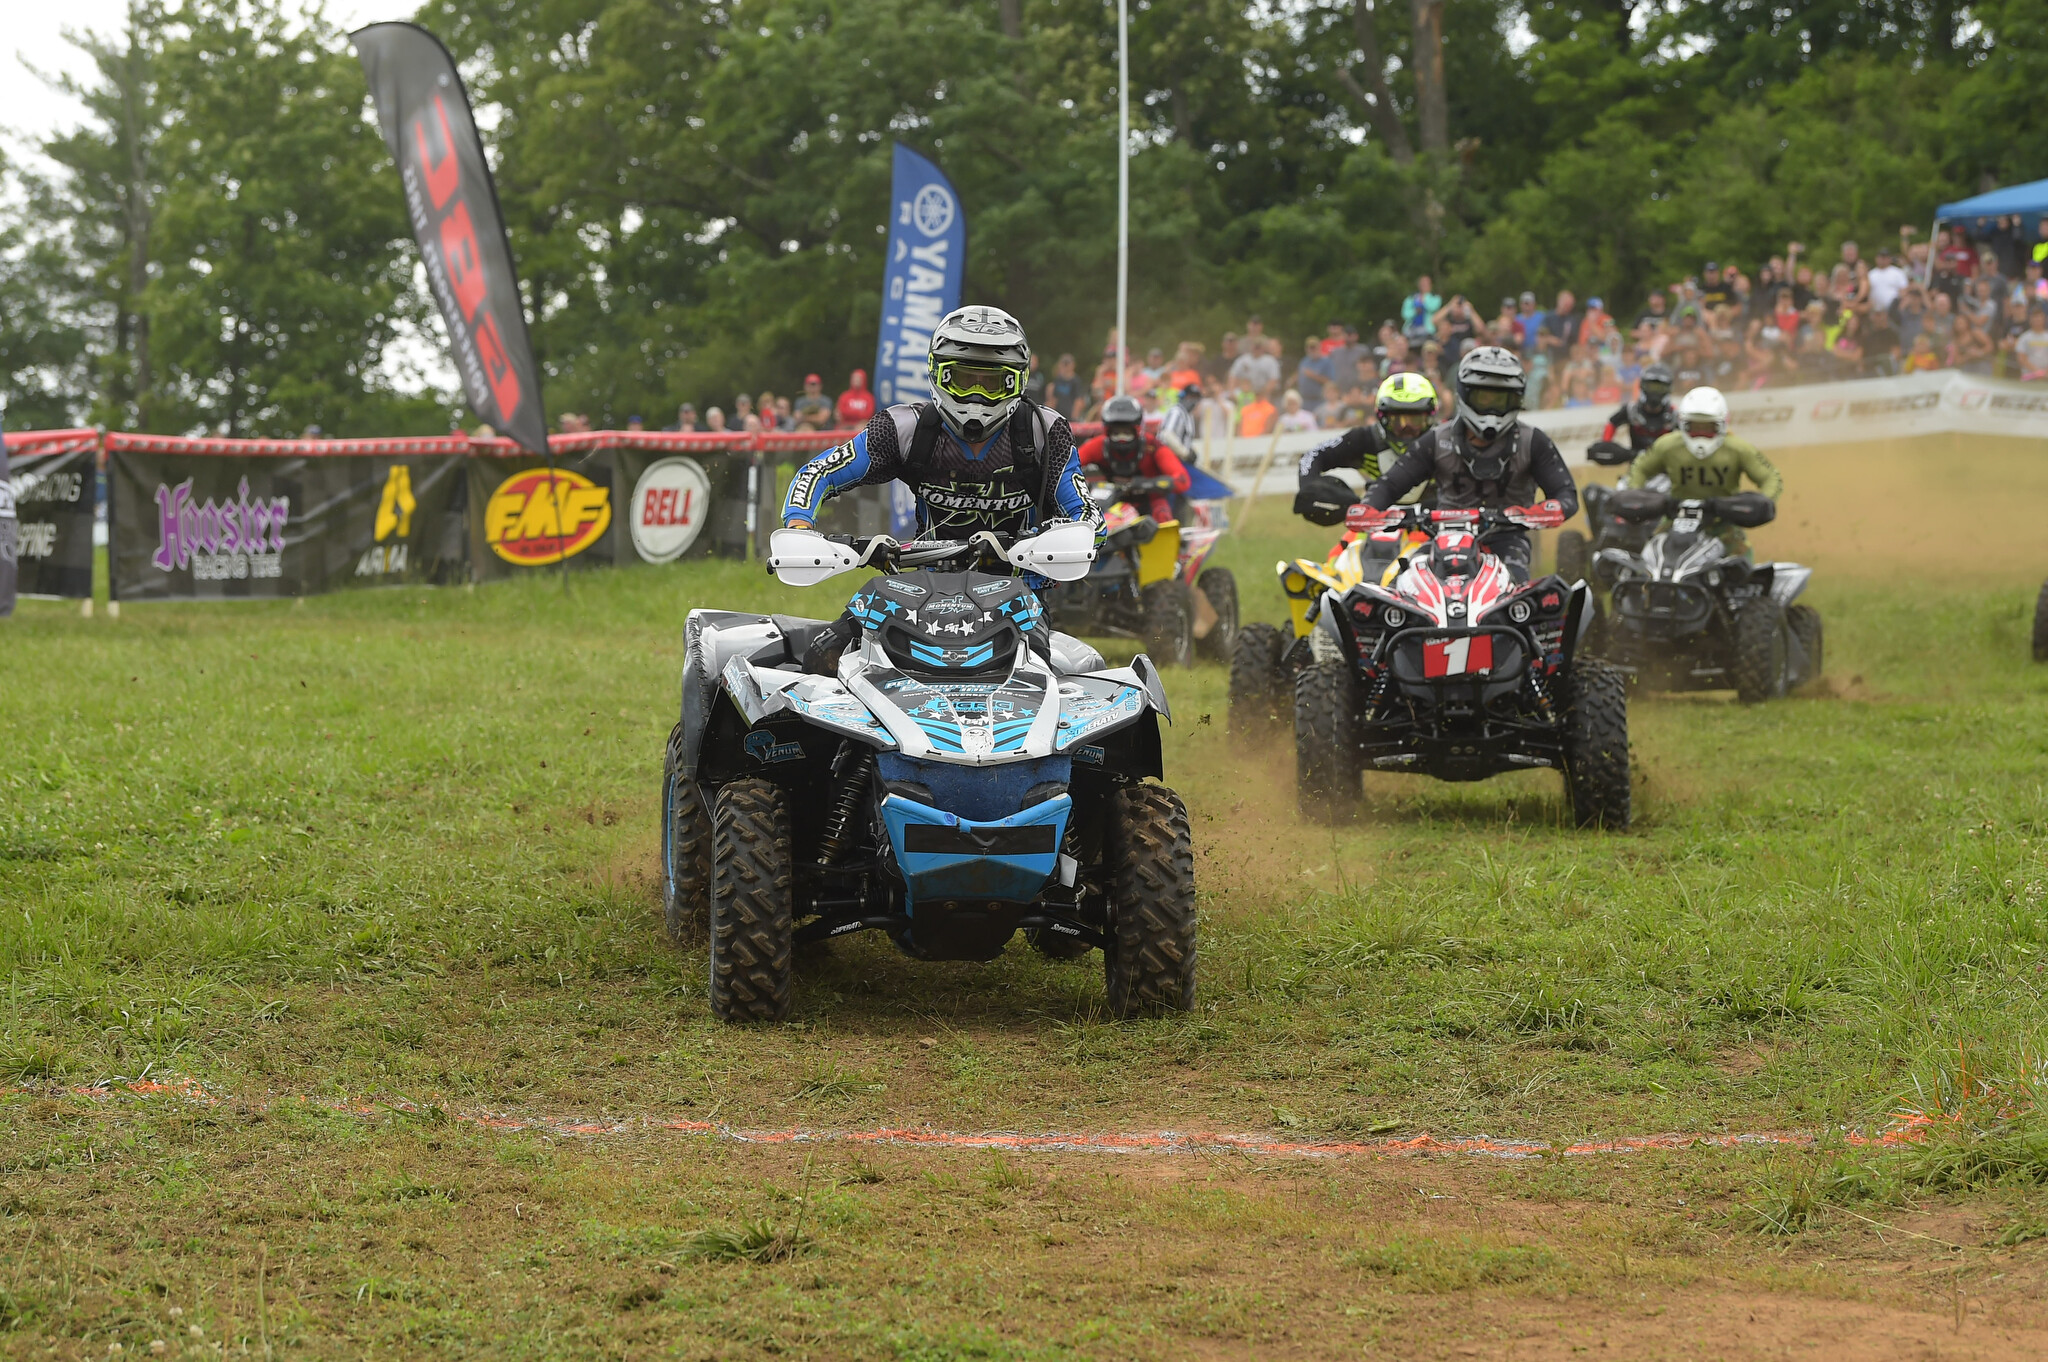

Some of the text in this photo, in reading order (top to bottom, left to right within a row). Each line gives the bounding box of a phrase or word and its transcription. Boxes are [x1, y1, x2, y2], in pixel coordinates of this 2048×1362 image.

[879, 201, 913, 404] RACING
[1680, 465, 1729, 487] FLY
[486, 479, 609, 543] FMF
[643, 489, 693, 526] BELL
[1443, 636, 1471, 676] 1
[1076, 749, 1104, 762] ENUM
